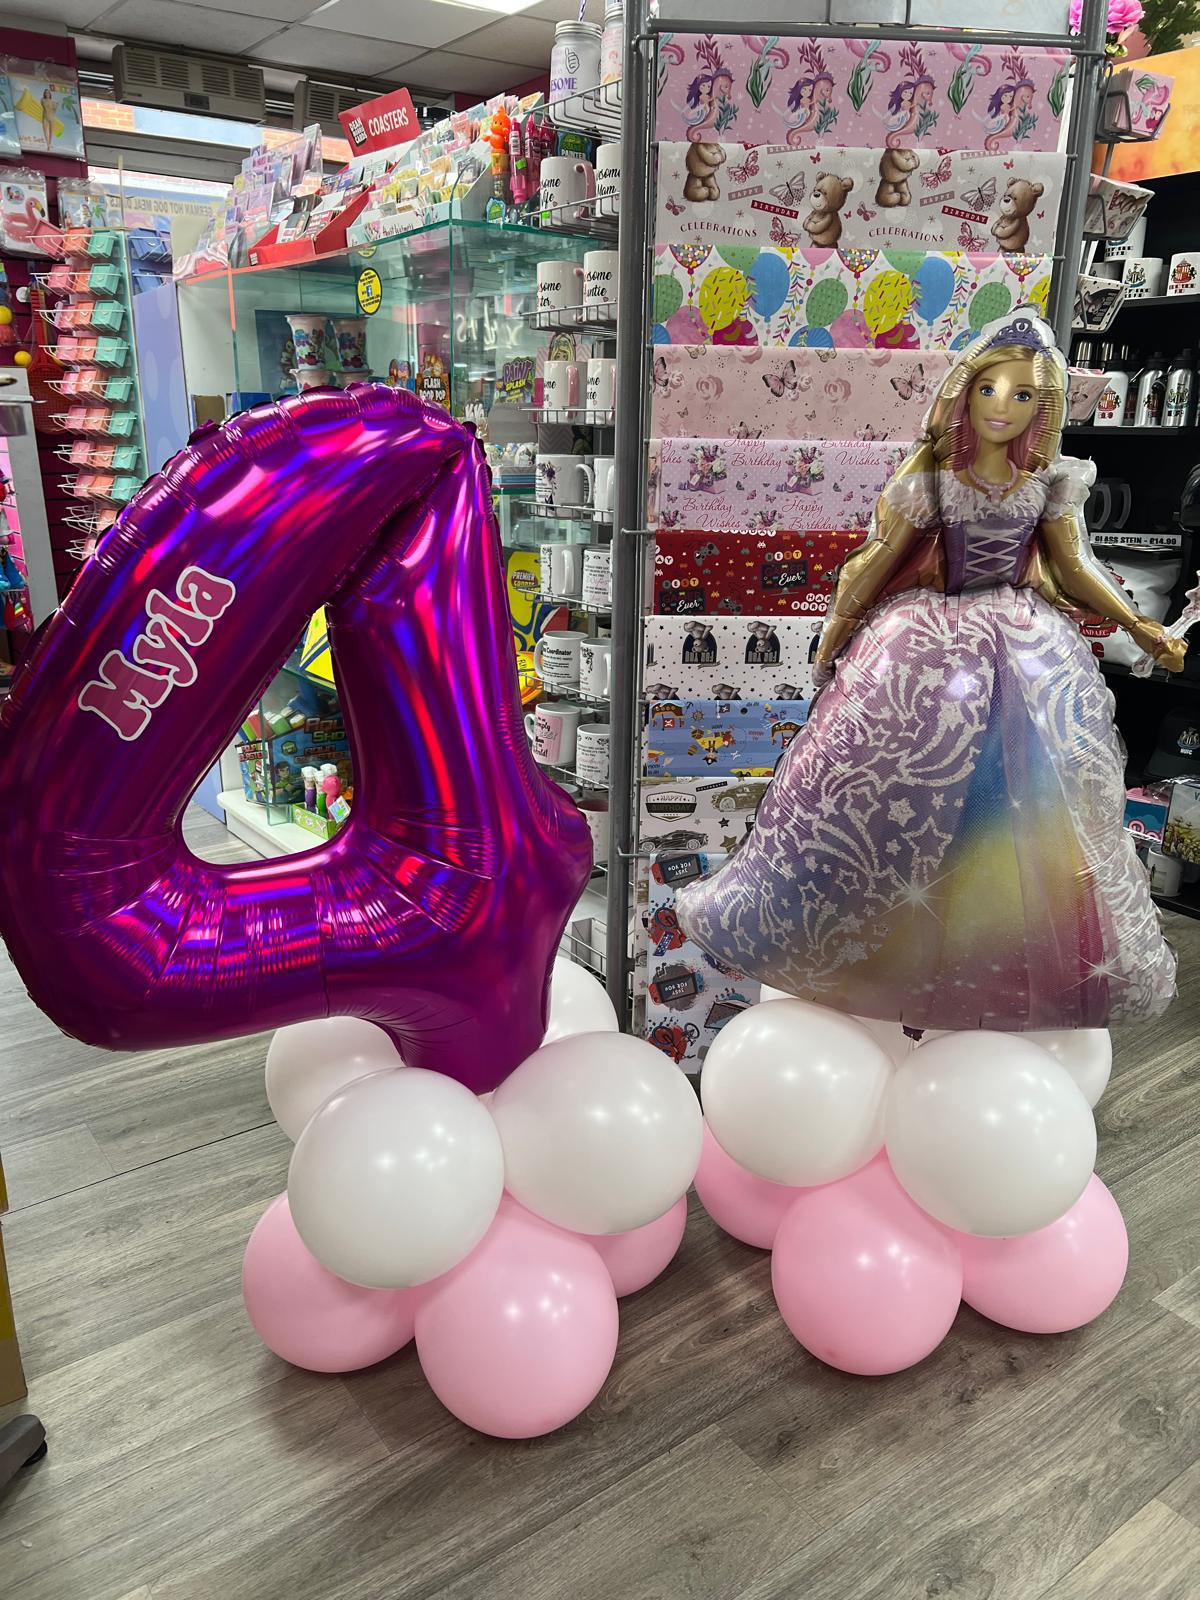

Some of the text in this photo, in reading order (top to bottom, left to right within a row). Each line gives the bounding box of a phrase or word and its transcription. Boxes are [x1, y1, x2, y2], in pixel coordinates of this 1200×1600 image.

[368, 107, 409, 137] COASTERS
[731, 187, 760, 199] HAPPY
[753, 201, 797, 217] BIRTHDAY
[944, 207, 986, 223] BIRTHDAY
[680, 221, 757, 237] CELEBRATIONS
[868, 227, 944, 242] CELEBRATIONS
[503, 360, 532, 385] PAINT
[424, 379, 441, 388] FLASH
[435, 390, 446, 400] POP
[730, 452, 782, 473] Birthday
[834, 450, 880, 465] Wishes
[682, 497, 732, 518] Birthday
[782, 499, 823, 519] Happy
[695, 513, 741, 528] Wishes
[1120, 536, 1142, 544] STEIN
[765, 551, 801, 560] BEST
[779, 572, 802, 586] Ever
[677, 600, 700, 613] Ever
[78, 566, 236, 741] Myla
